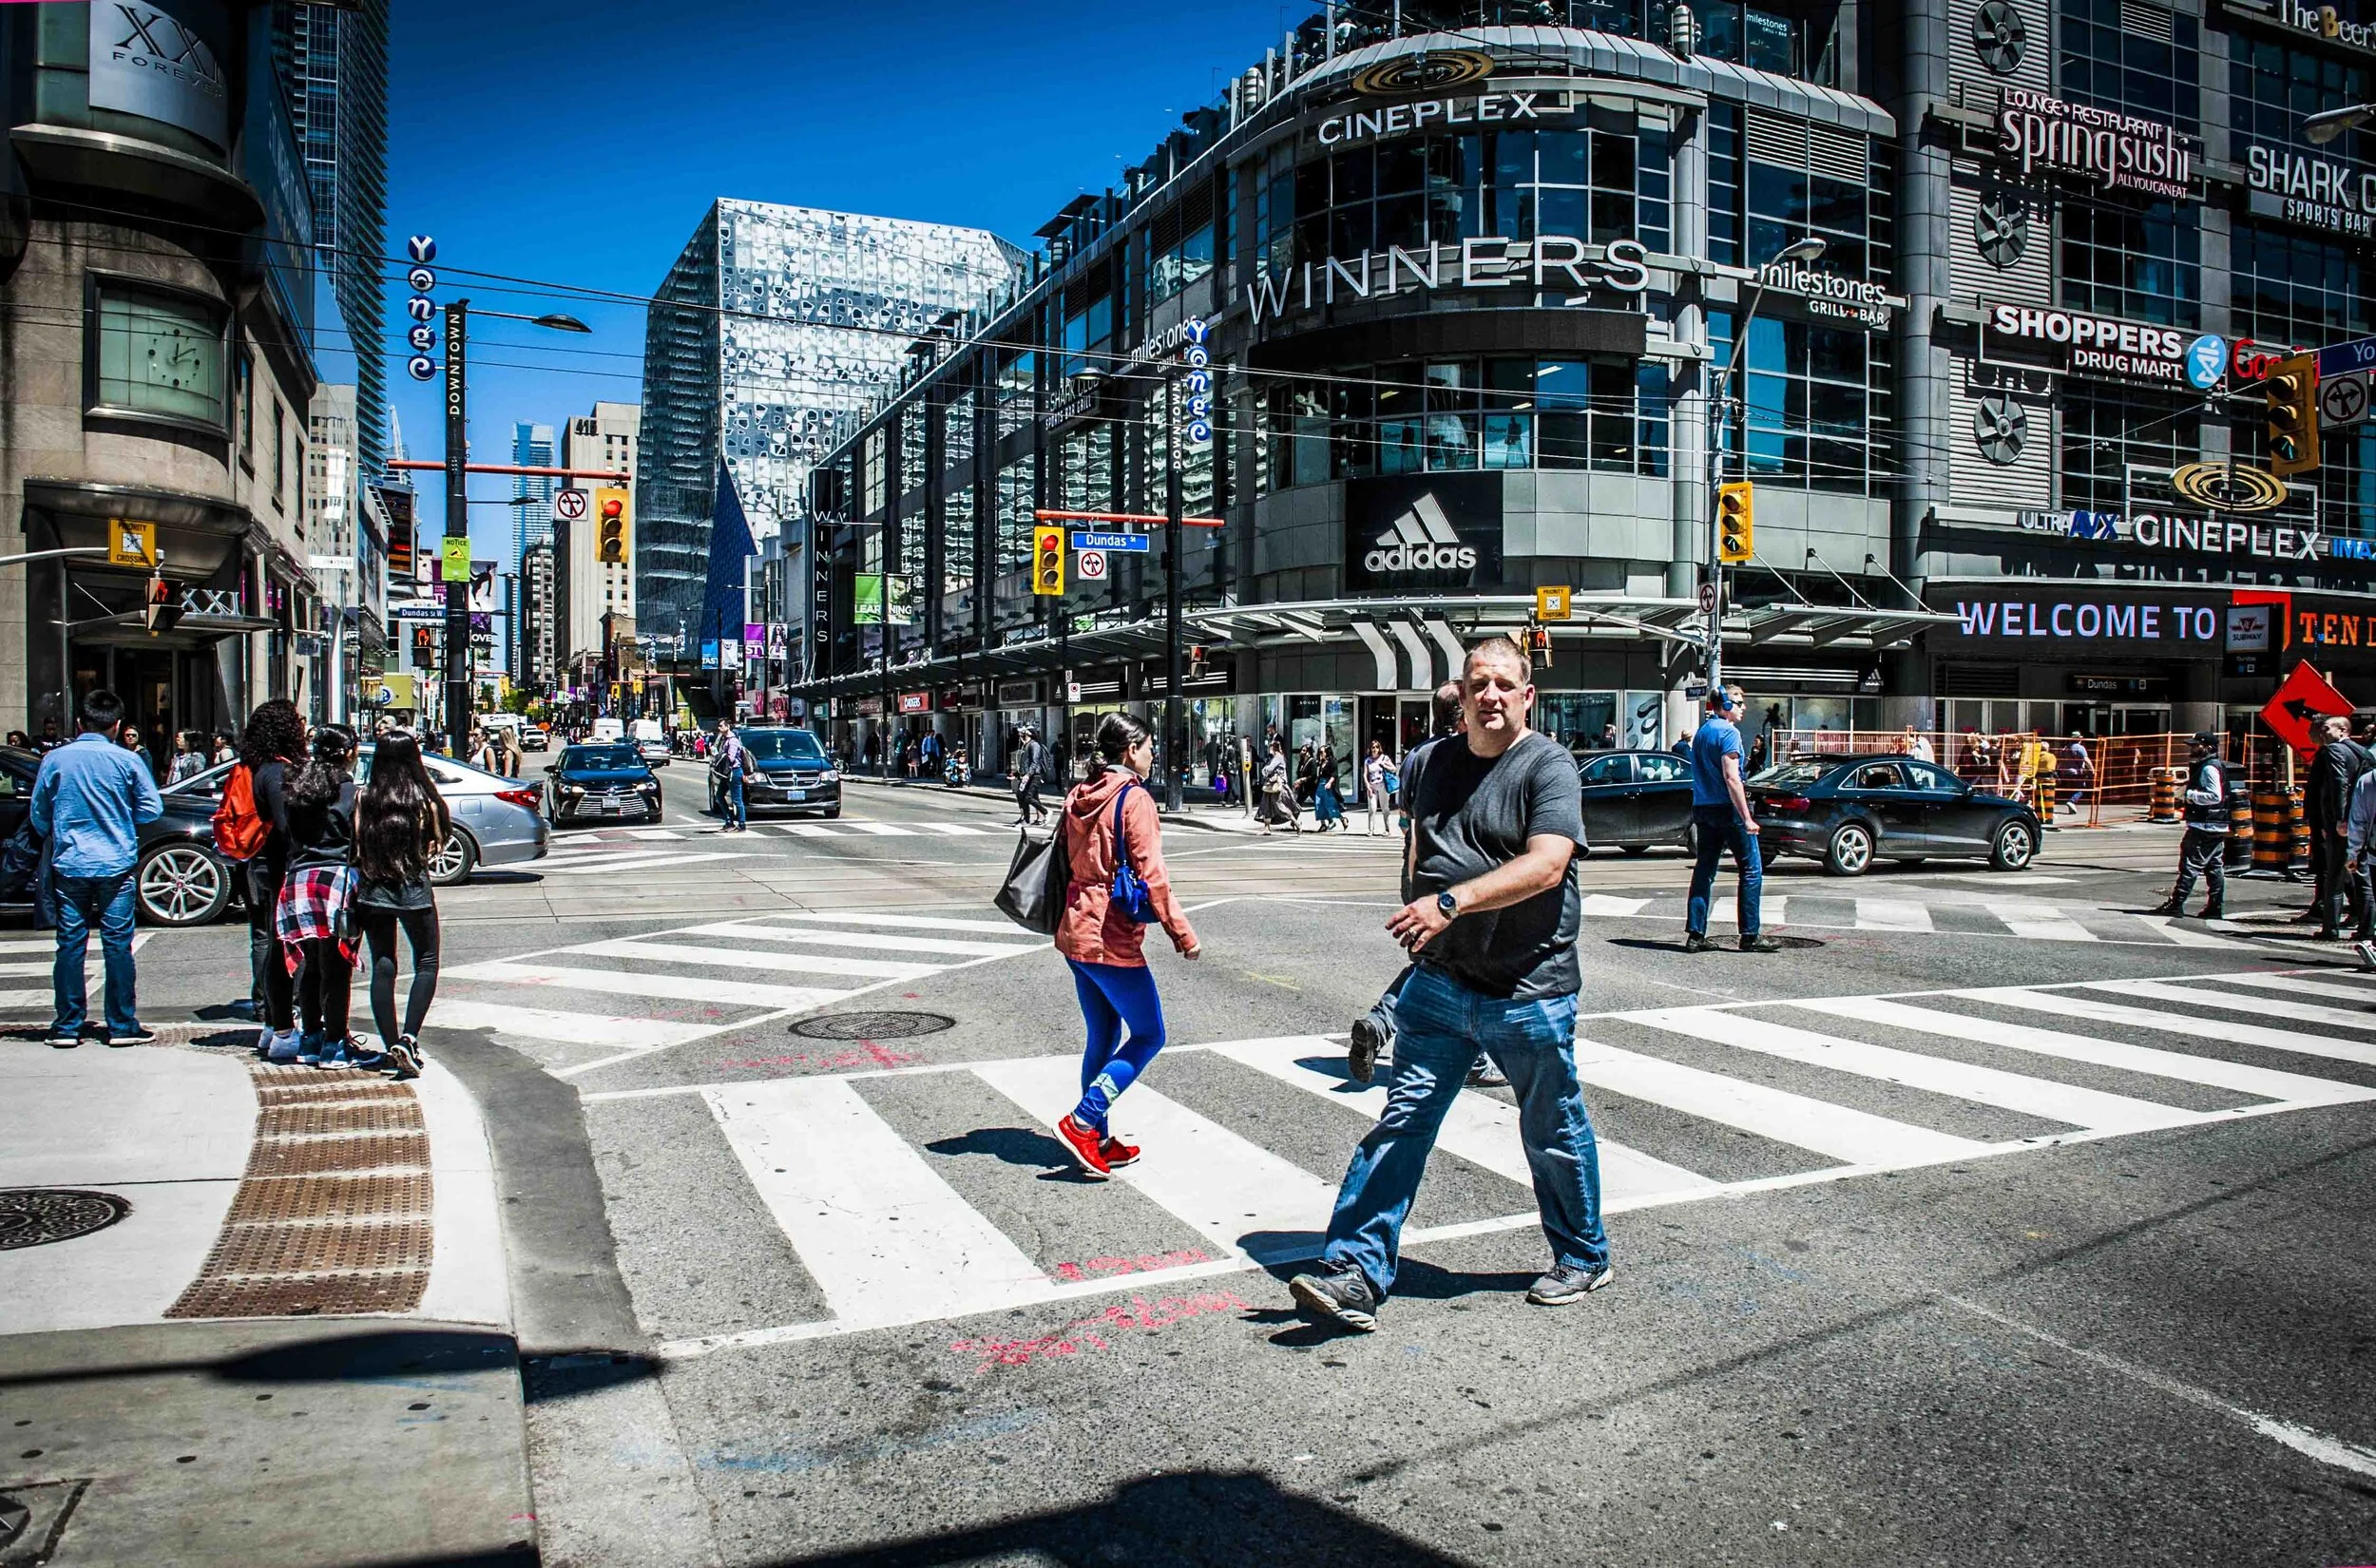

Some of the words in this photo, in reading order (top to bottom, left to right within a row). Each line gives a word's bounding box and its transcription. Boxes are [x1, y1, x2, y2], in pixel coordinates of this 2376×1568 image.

[1746, 14, 1787, 31] milestones
[1318, 92, 1539, 144] CINEPLEX
[2004, 87, 2063, 116] LOUNGE
[2072, 104, 2162, 140] RESTAURANT
[2249, 145, 2350, 208] SHARK
[2288, 199, 2338, 225] SPORTS
[2345, 211, 2369, 233] BAR
[1247, 236, 1650, 325] WINNERS
[1760, 260, 1887, 305] milestones
[1810, 300, 1847, 317] GRILL
[1859, 309, 1885, 325] BAR
[1995, 305, 2182, 359] SHOPPERS
[449, 314, 461, 415] DOWNTOWN
[2075, 349, 2129, 373] DRUG
[2132, 357, 2183, 380] MART
[1172, 383, 1181, 469] DOWNTOWN
[2022, 511, 2070, 532] ULTRA
[2134, 514, 2320, 561] CINEPLEX
[1085, 534, 1127, 546] Dundas
[1365, 543, 1477, 572] adidas
[2332, 538, 2376, 558] IMA
[814, 511, 831, 642] WINNERS
[471, 634, 492, 642] OVE
[1957, 602, 2160, 638] WELCOME
[2173, 606, 2215, 640] TO
[2232, 633, 2262, 641] SUBWAY
[2087, 679, 2117, 690] Dundas
